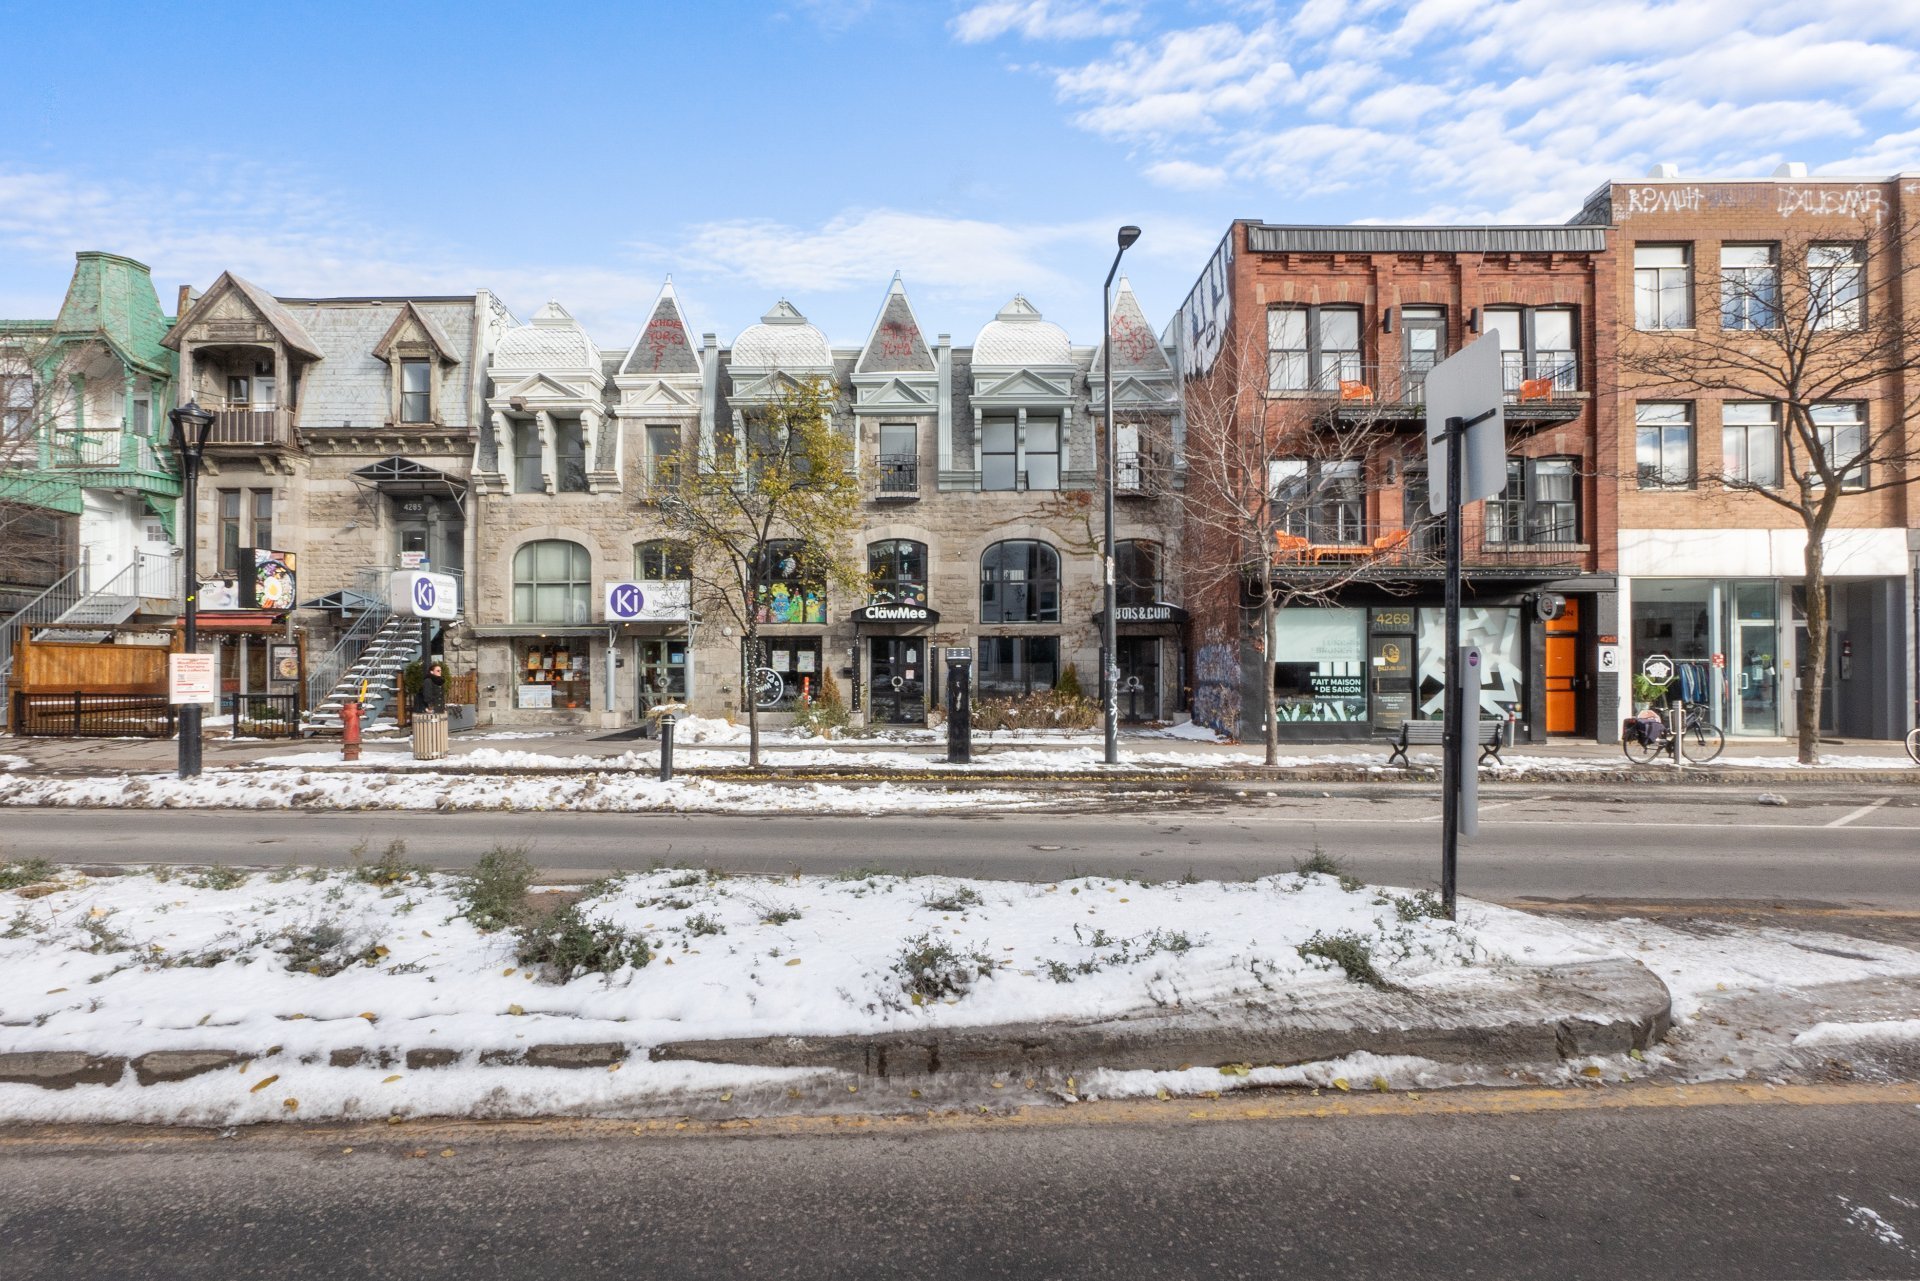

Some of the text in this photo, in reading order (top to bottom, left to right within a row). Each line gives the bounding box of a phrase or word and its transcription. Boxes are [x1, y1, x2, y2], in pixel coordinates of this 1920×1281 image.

[417, 582, 433, 606] Ki
[616, 588, 639, 613] Ki
[865, 606, 928, 619] CläwMee
[1376, 613, 1410, 625] 4269
[1311, 678, 1361, 686] FAIT MAISON
